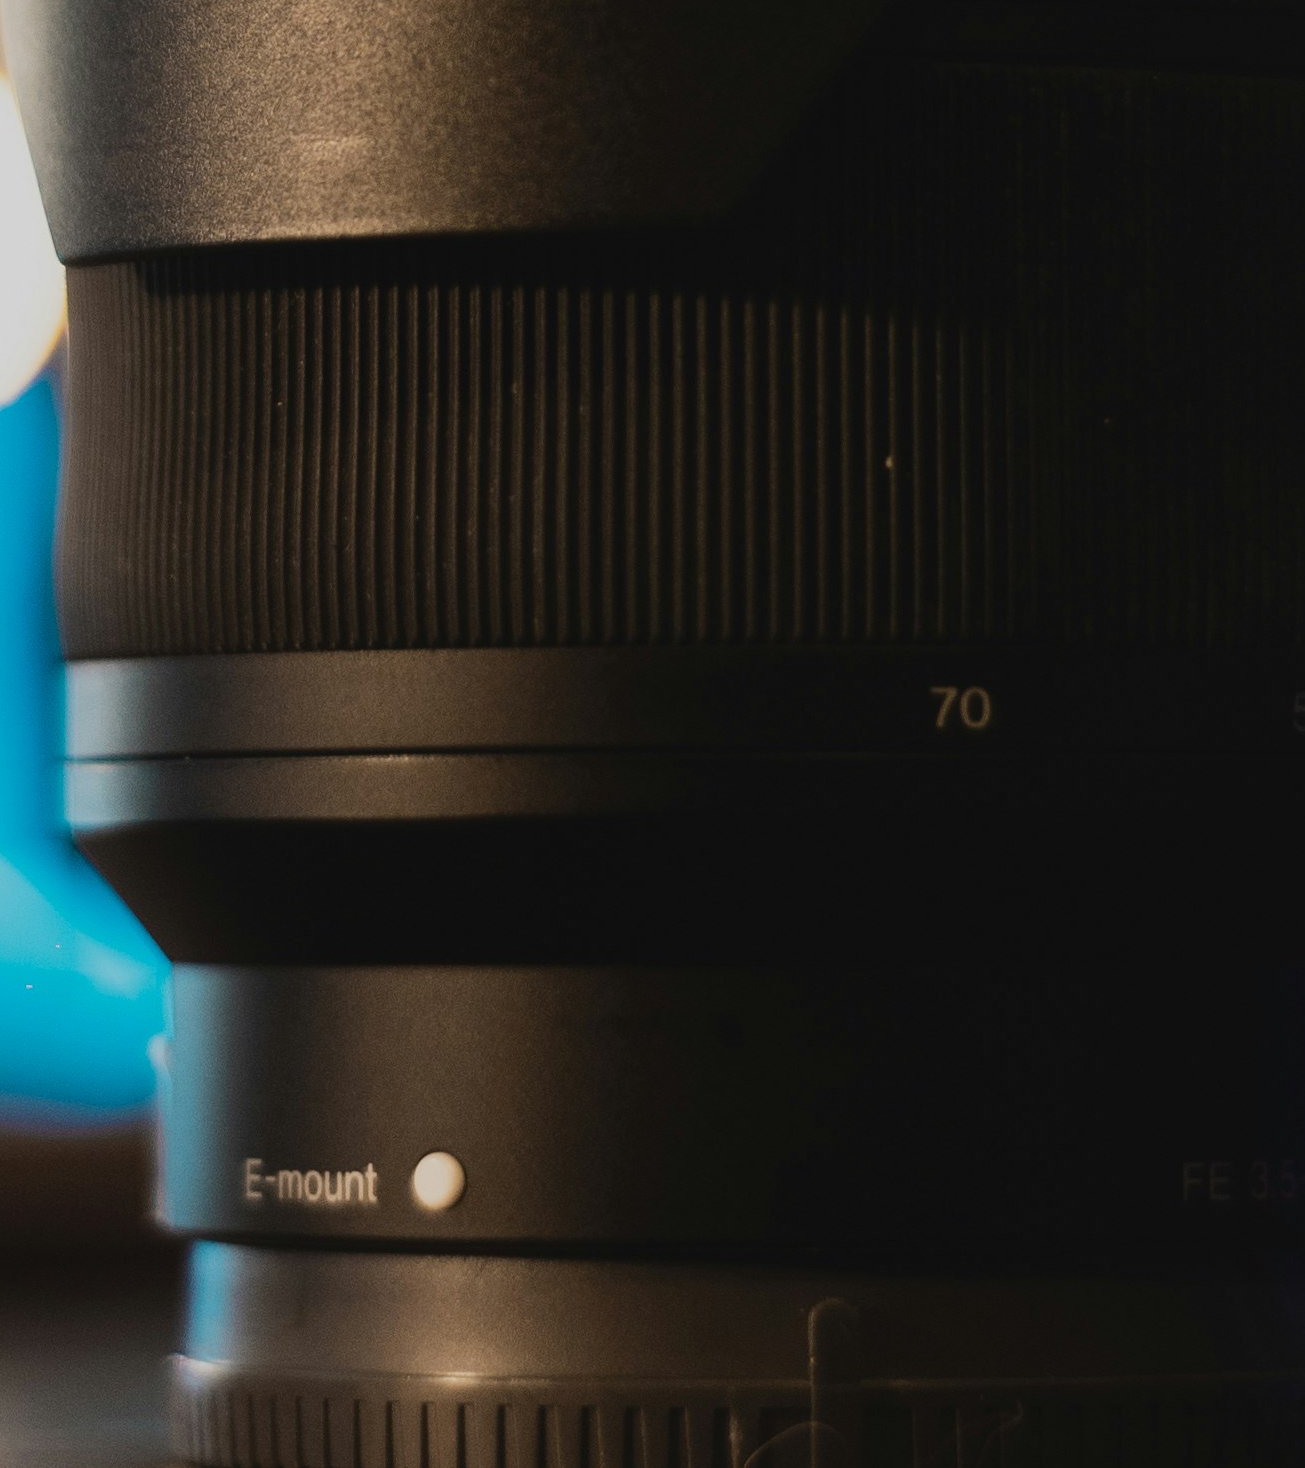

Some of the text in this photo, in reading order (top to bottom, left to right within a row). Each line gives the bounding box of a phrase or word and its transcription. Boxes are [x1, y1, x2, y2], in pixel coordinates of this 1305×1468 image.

[929, 685, 993, 730] 70
[244, 1157, 379, 1204] E-mount
[1181, 1160, 1232, 1202] FE
